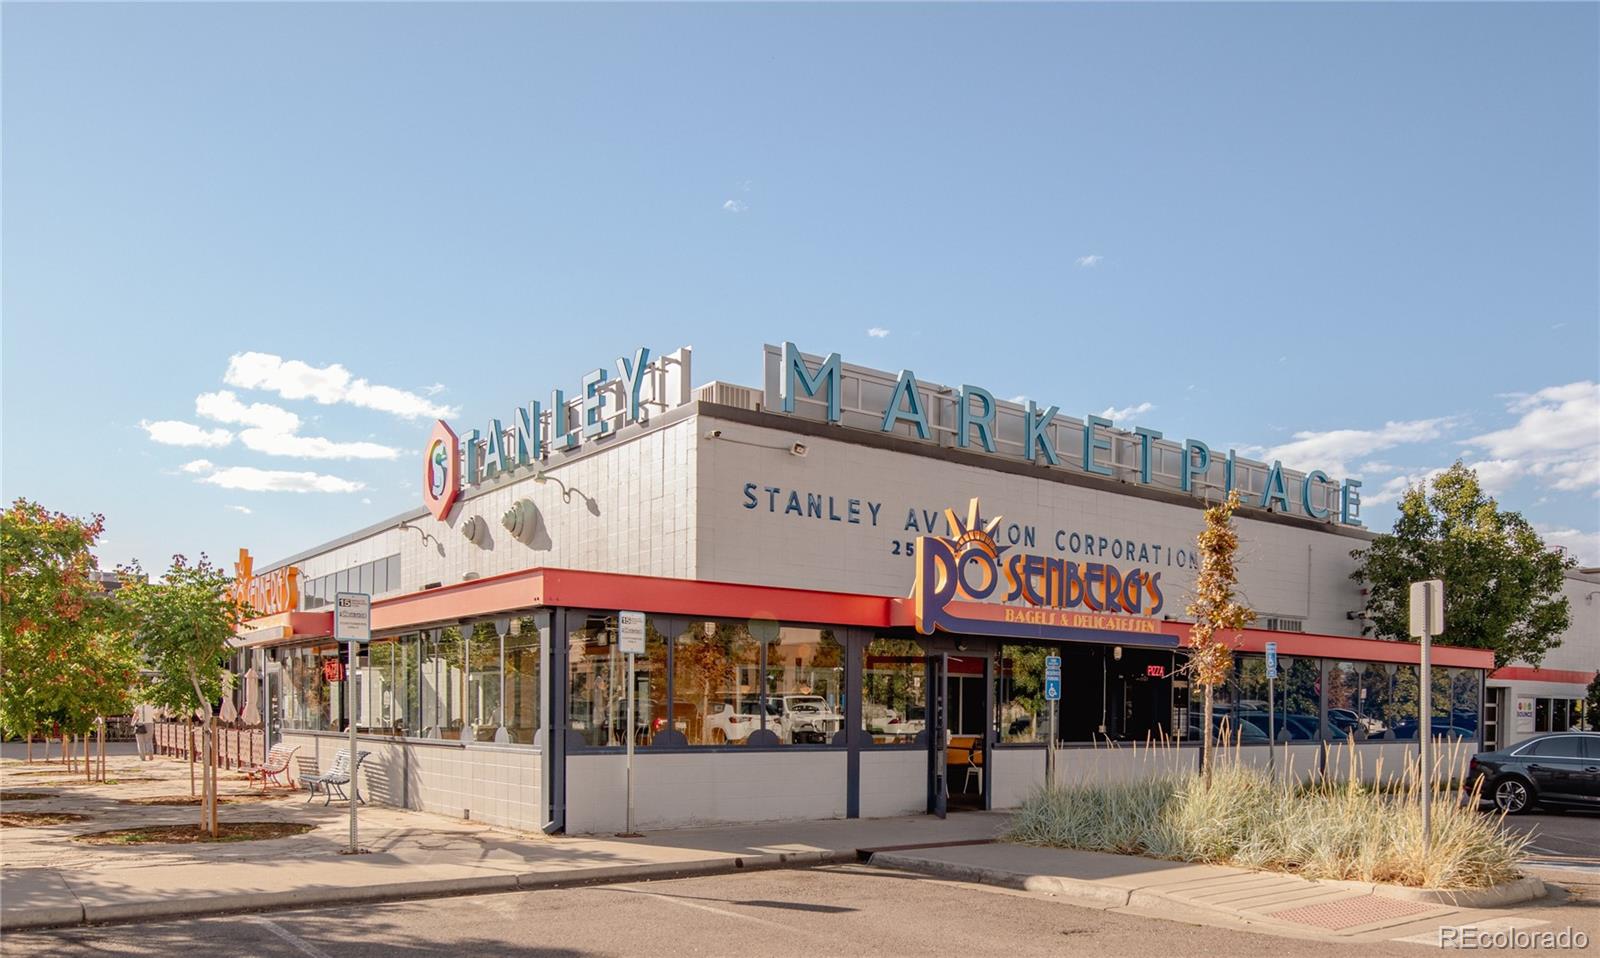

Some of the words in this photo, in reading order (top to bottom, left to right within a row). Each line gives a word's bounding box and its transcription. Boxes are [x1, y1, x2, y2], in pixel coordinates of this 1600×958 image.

[780, 341, 1362, 526] MARKETPLACE
[743, 482, 882, 526] STANLEY
[1055, 529, 1198, 570] CORPORATION
[916, 536, 1164, 635] ROSENBERG'S
[1005, 608, 1055, 626] BAGELS
[1060, 614, 1069, 627] &
[1073, 614, 1156, 633] DELICATESSEN
[1147, 665, 1165, 677] PIZZA
